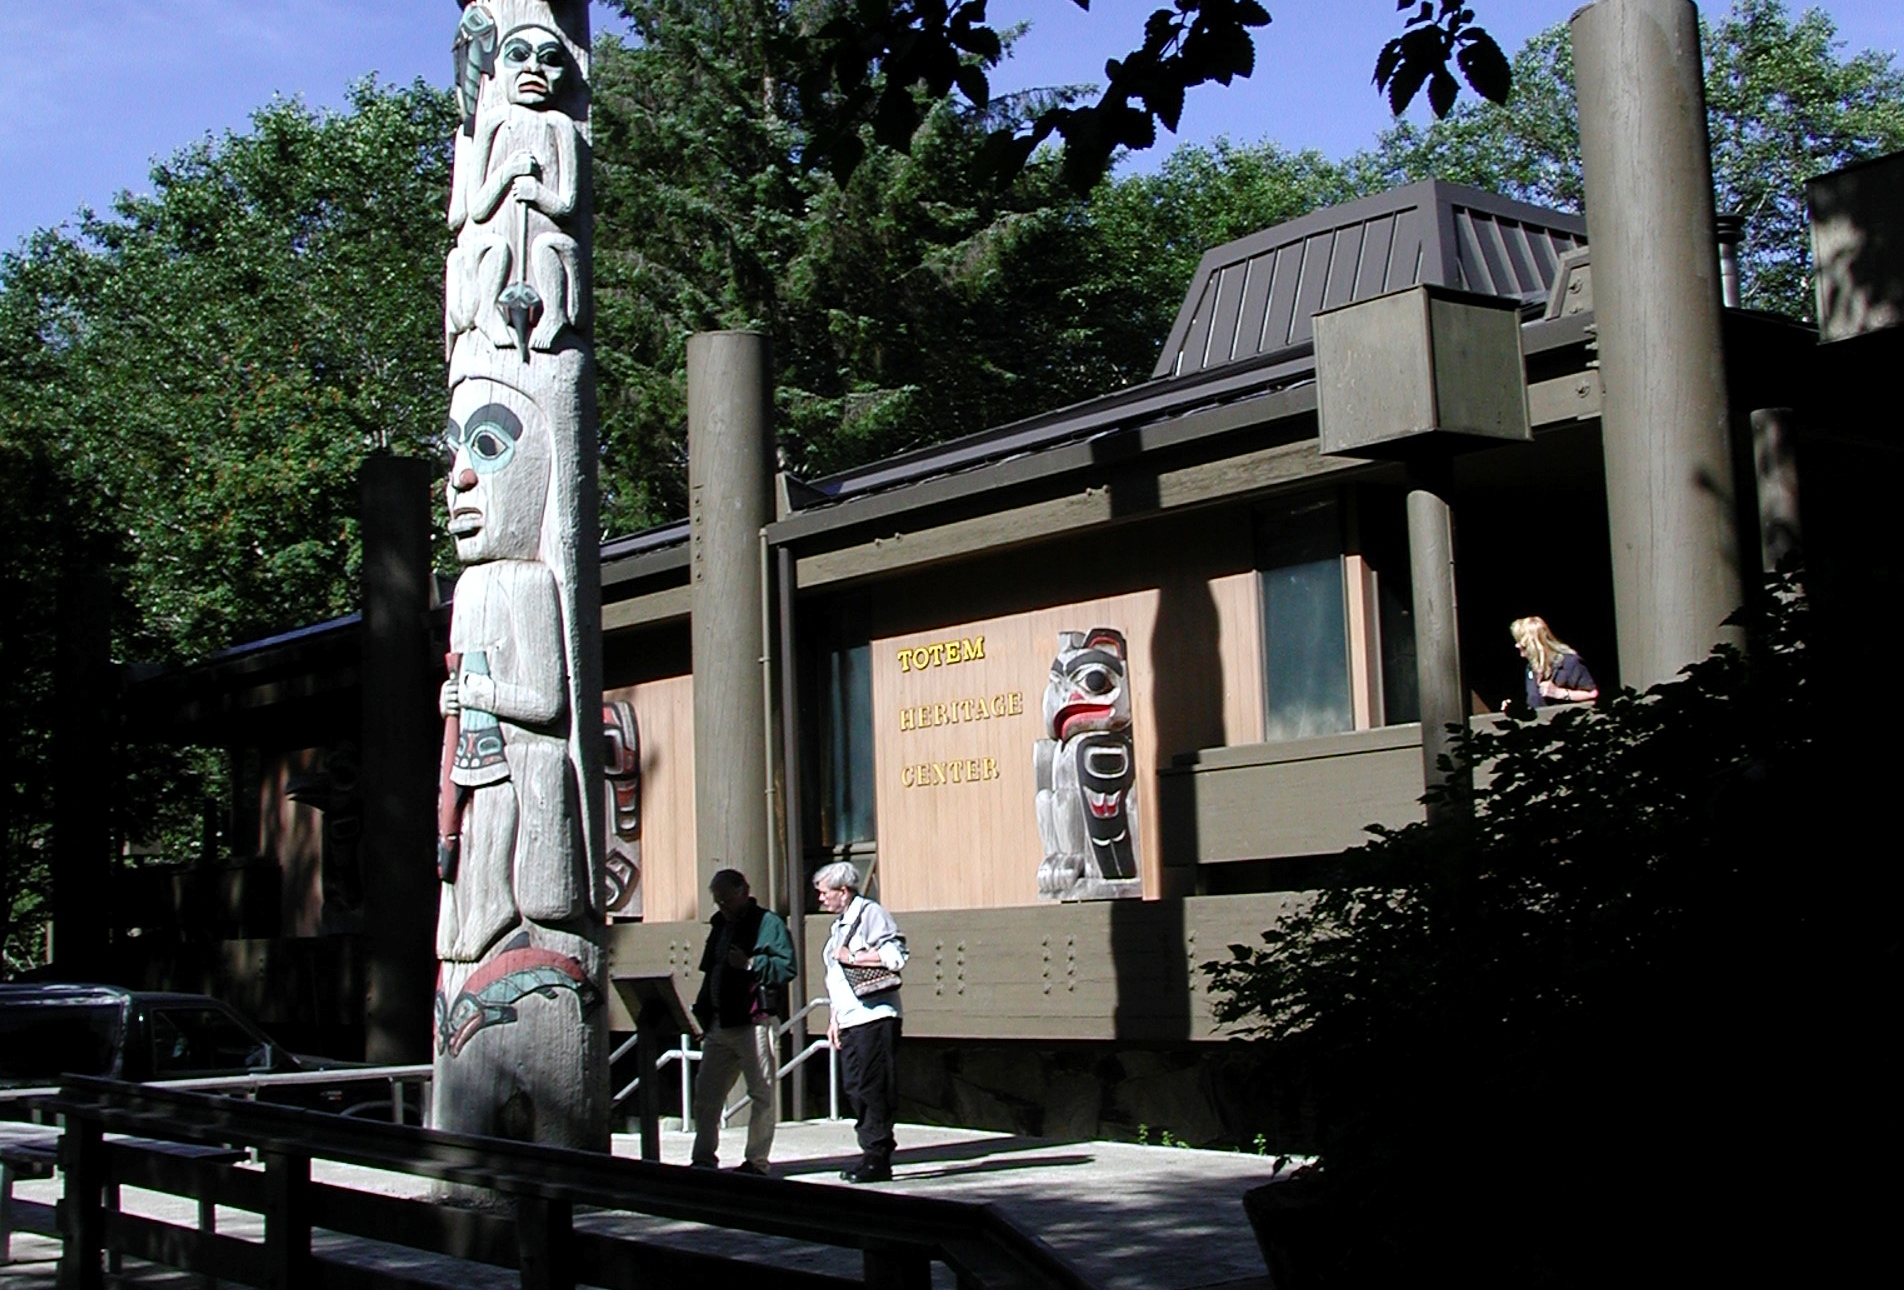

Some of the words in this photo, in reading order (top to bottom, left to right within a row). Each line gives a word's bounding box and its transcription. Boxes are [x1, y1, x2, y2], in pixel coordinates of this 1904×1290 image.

[897, 636, 985, 672] TOTEM
[900, 692, 1023, 731] HERITAGE
[901, 757, 1000, 787] CENTER
